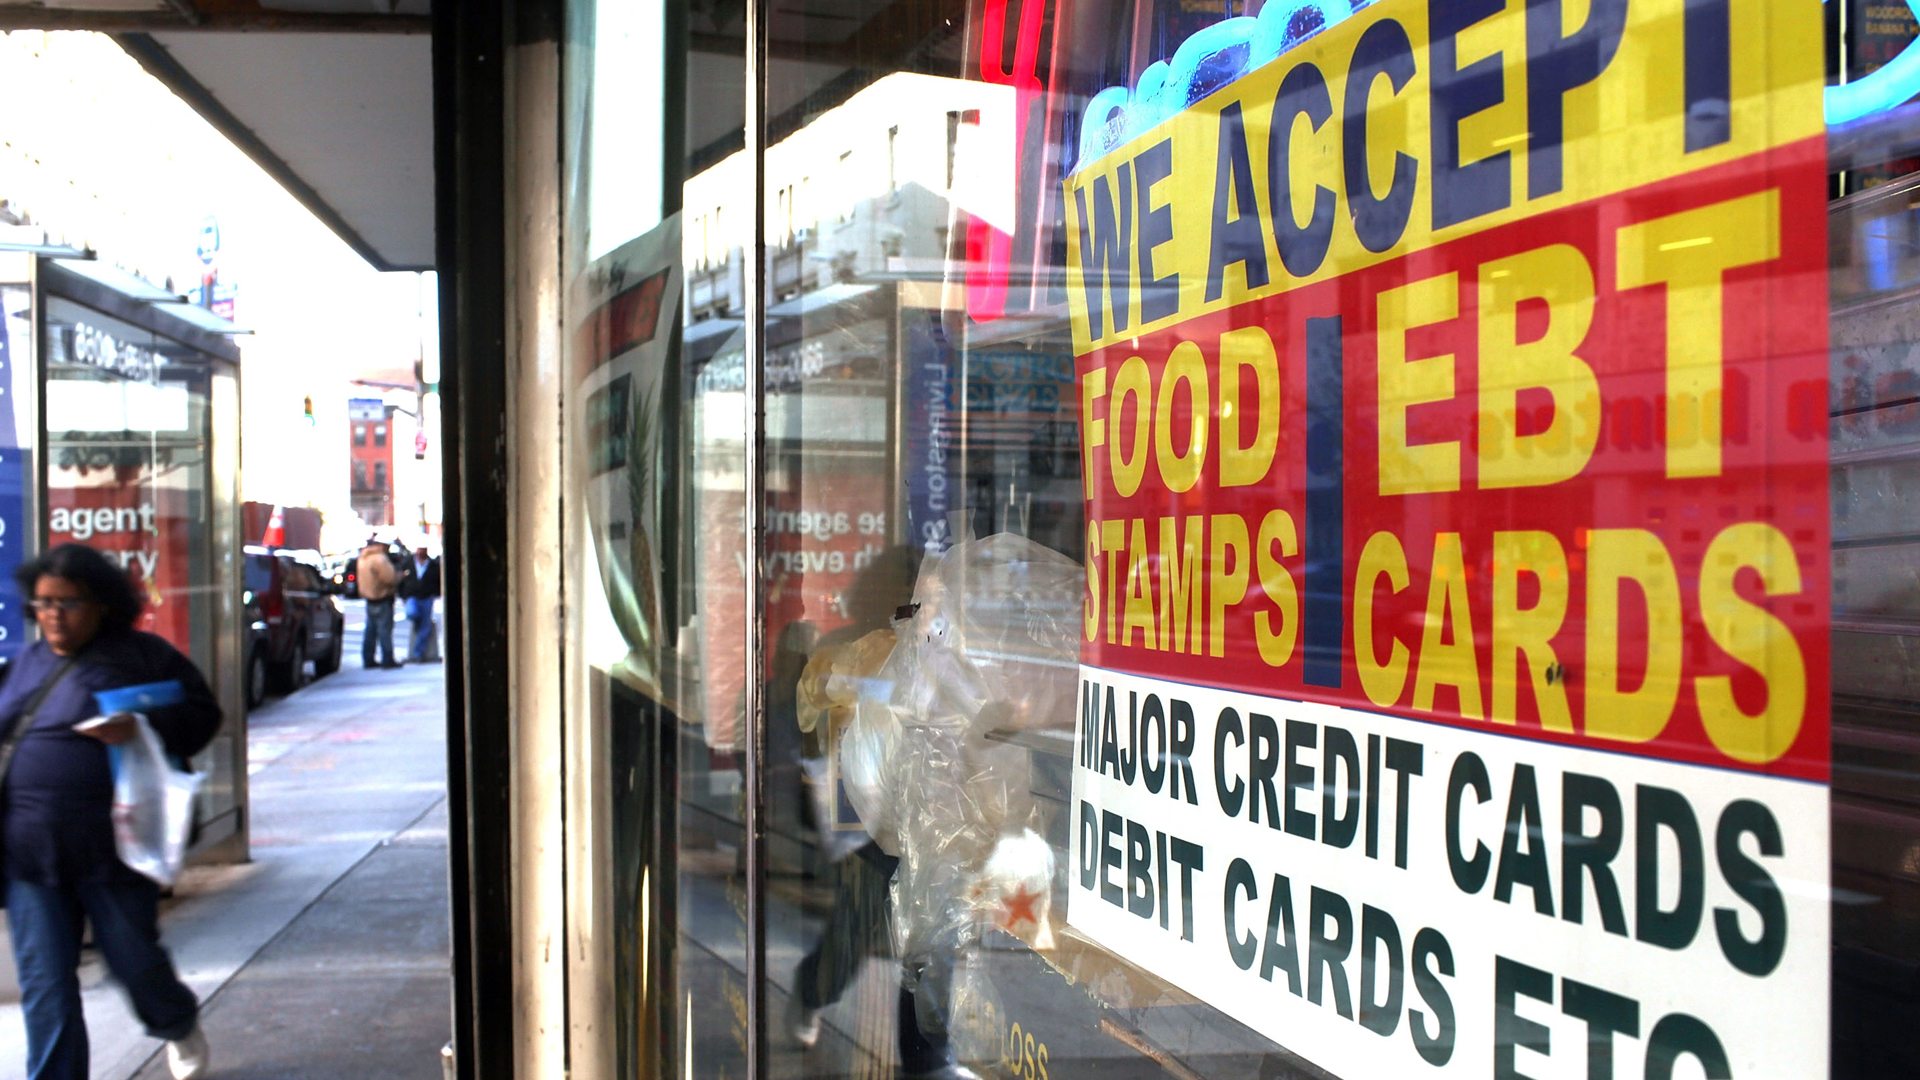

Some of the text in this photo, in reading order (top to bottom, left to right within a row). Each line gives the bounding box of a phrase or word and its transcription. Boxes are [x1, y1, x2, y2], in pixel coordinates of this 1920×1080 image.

[1074, 137, 1179, 342] WE
[1377, 187, 1781, 496] EBT
[50, 502, 157, 540] agent
[1082, 325, 1281, 500] FOOD
[1084, 509, 1299, 667] STAMPS
[1353, 522, 1806, 764] CARDS
[1080, 679, 1788, 979] MAJOR CREDIT CARDS
[1080, 799, 1204, 944] DEBIT
[1223, 857, 1456, 1068] CARDS
